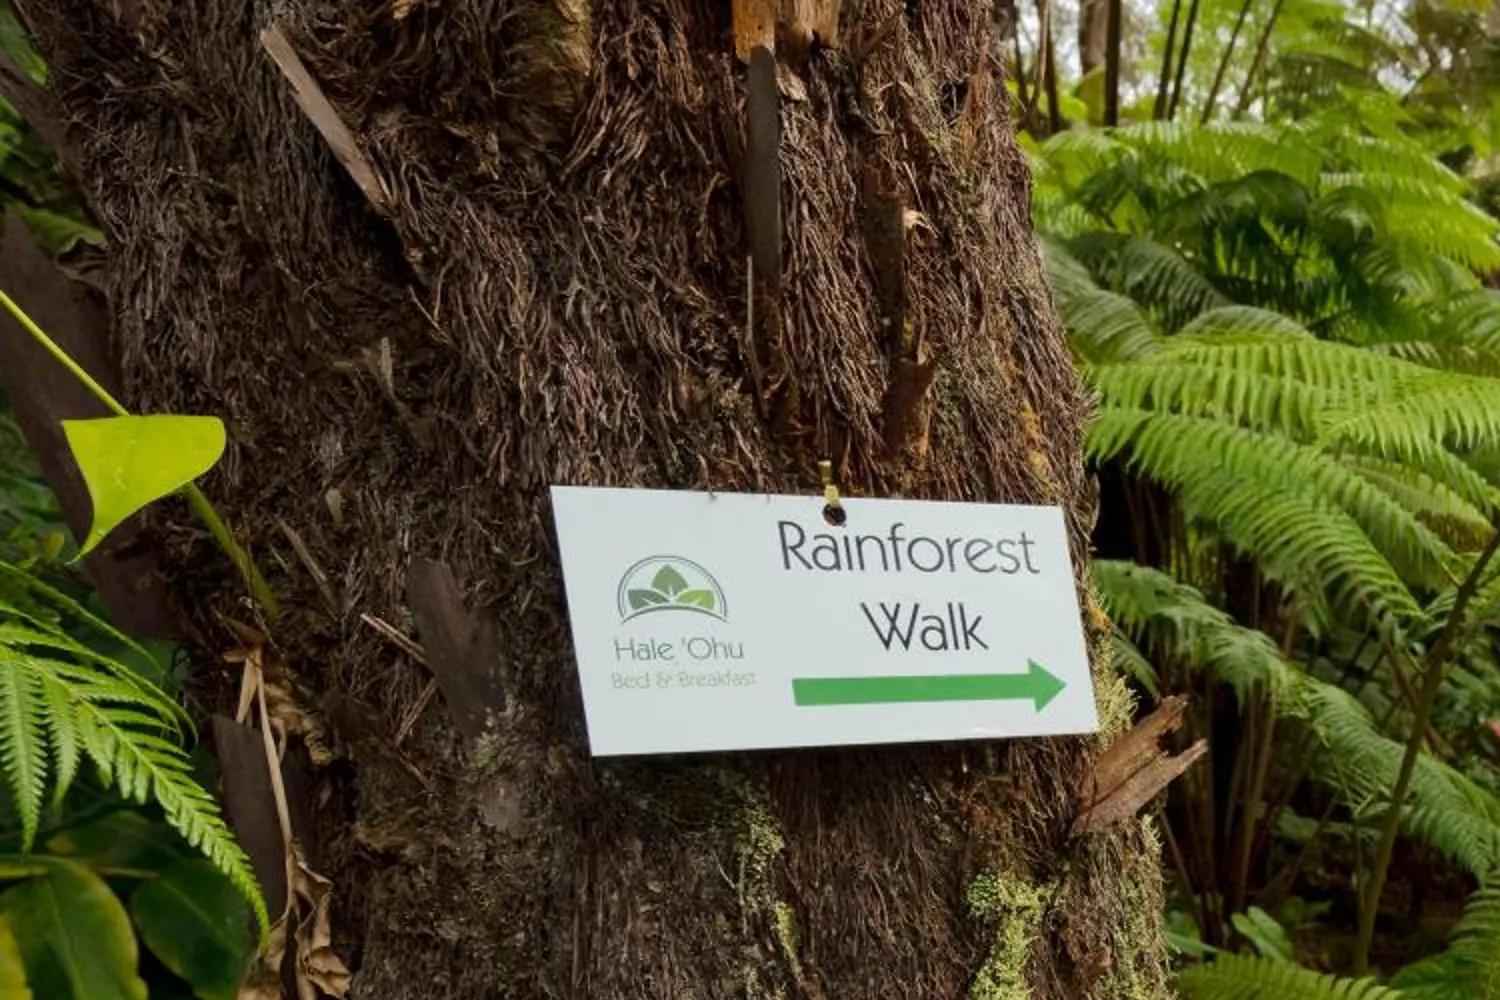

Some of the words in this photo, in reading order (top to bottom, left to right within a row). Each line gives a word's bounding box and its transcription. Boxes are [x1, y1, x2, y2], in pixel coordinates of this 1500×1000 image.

[778, 520, 1040, 575] Rainforest
[860, 602, 989, 652] Walk
[614, 637, 675, 662] Hale
[611, 671, 651, 689] Bed
[656, 671, 673, 689] &
[677, 669, 756, 688] Breakfast
